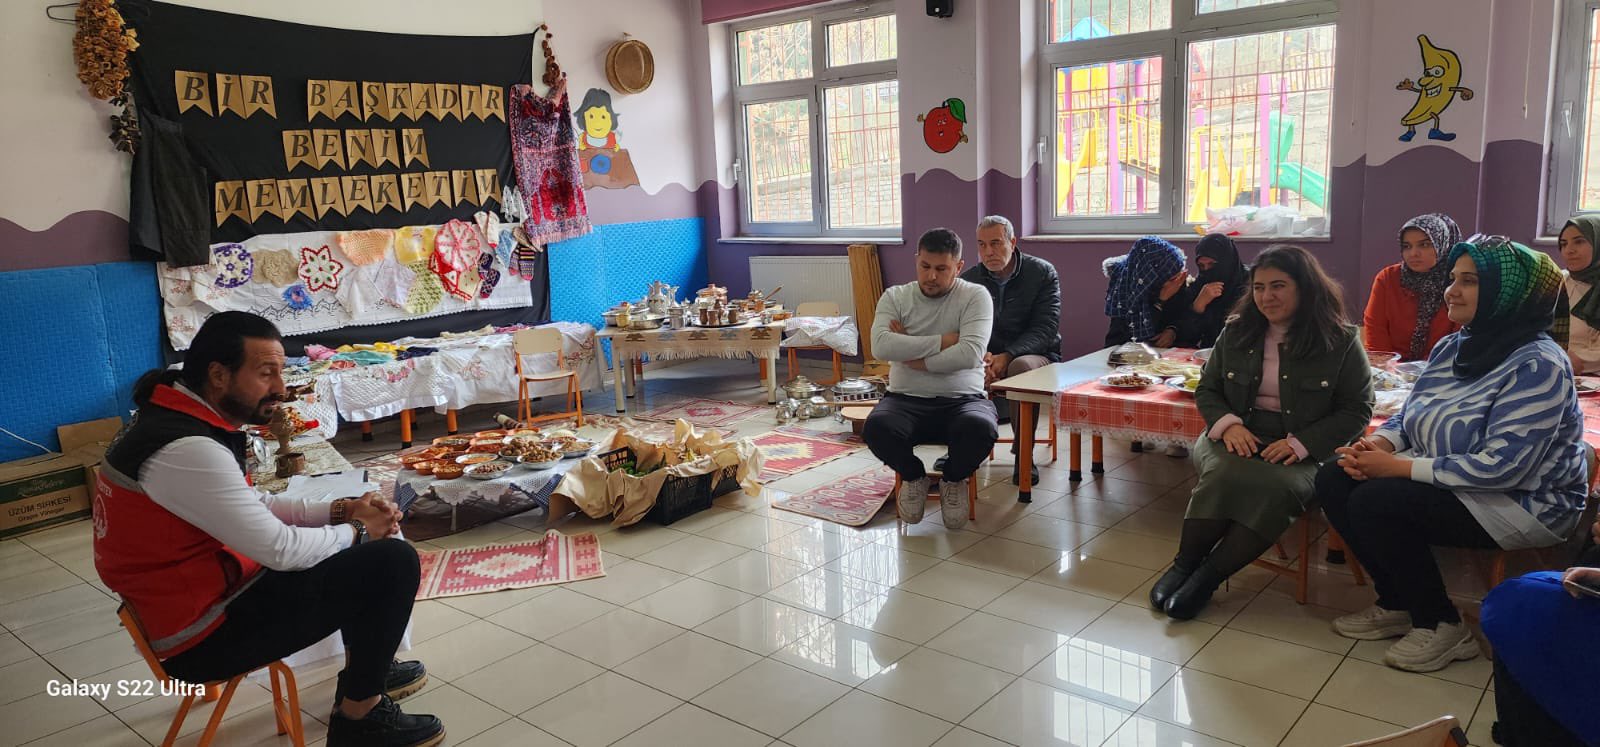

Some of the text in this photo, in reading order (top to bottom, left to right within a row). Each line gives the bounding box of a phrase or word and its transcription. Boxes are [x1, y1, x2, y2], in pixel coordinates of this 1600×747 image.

[183, 75, 501, 113] BİR BAŞKADIR
[289, 130, 424, 158] BENİM
[216, 171, 497, 213] MEMLEKETİM
